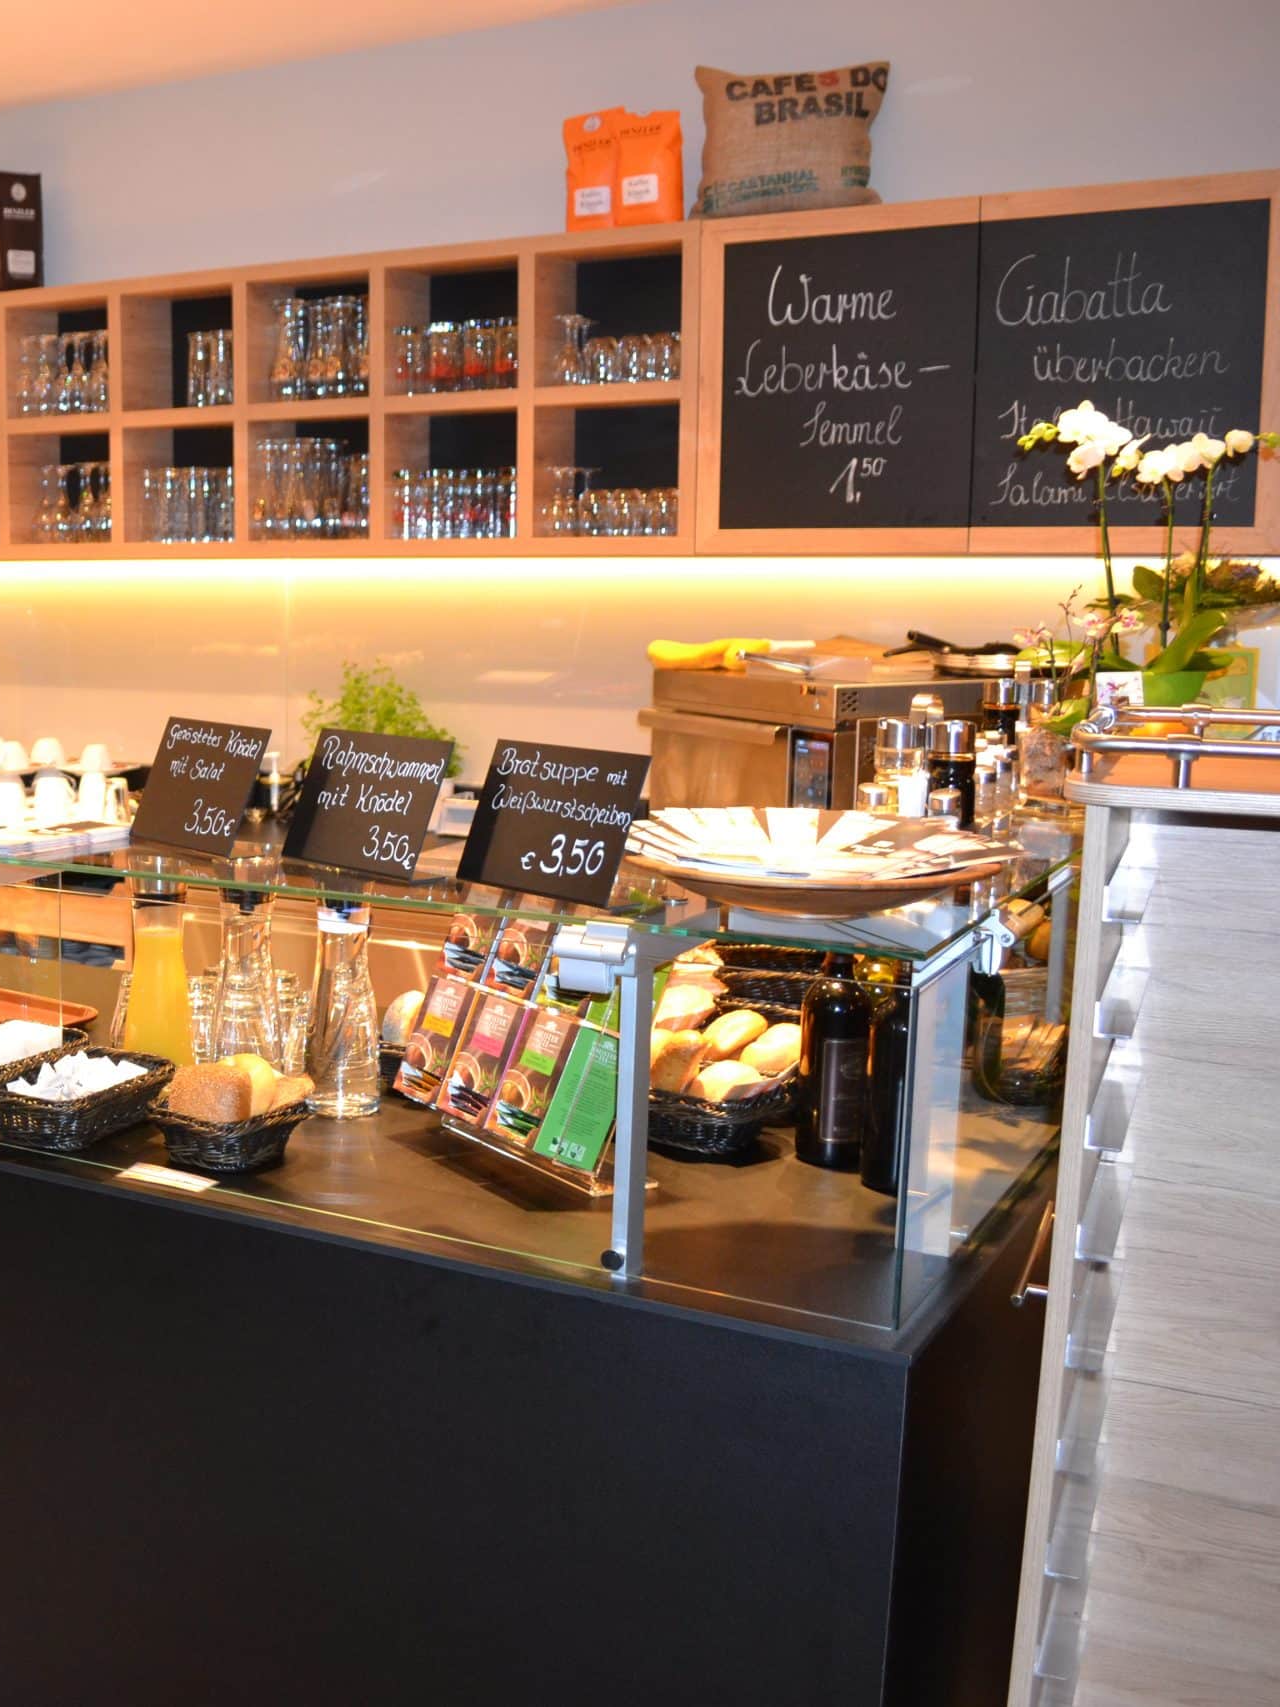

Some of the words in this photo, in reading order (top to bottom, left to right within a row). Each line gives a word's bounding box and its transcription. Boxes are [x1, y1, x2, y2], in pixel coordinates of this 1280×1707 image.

[754, 91, 871, 126] BRASIL
[768, 264, 897, 326] Warme
[995, 251, 1172, 327] Ciabatta
[1033, 337, 1231, 384] überbacken
[800, 401, 903, 447] Semmel
[170, 755, 190, 777] mit
[190, 759, 225, 781] Salat
[606, 769, 628, 786] mit
[317, 784, 350, 810] mit
[355, 784, 413, 815] Knödel
[491, 783, 631, 832] Weißwurstscheiben
[540, 834, 605, 877] 3,50
